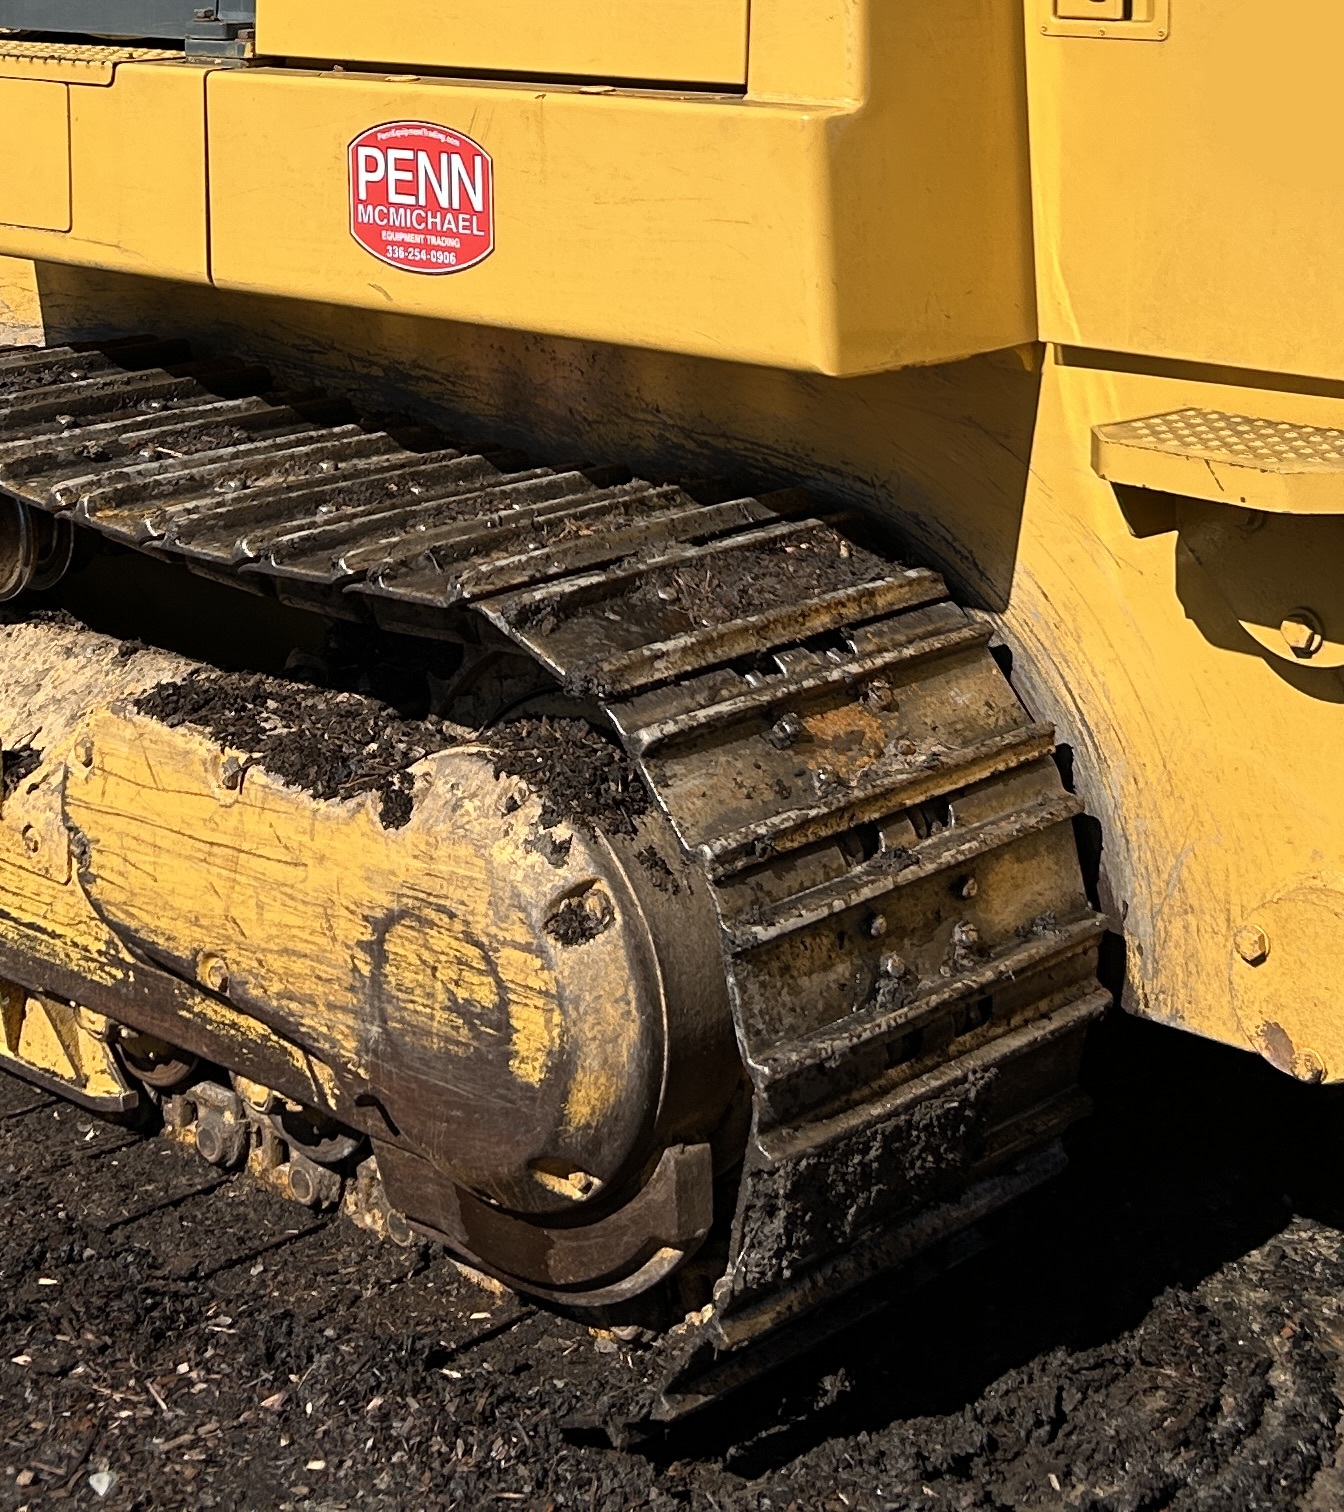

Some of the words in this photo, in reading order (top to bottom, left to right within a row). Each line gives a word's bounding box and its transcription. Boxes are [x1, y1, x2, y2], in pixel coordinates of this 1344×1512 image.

[357, 145, 484, 212] PENN
[357, 203, 485, 236] MCMICHAEL
[381, 230, 425, 245] EQUIPMENT
[426, 235, 461, 248] TRADING
